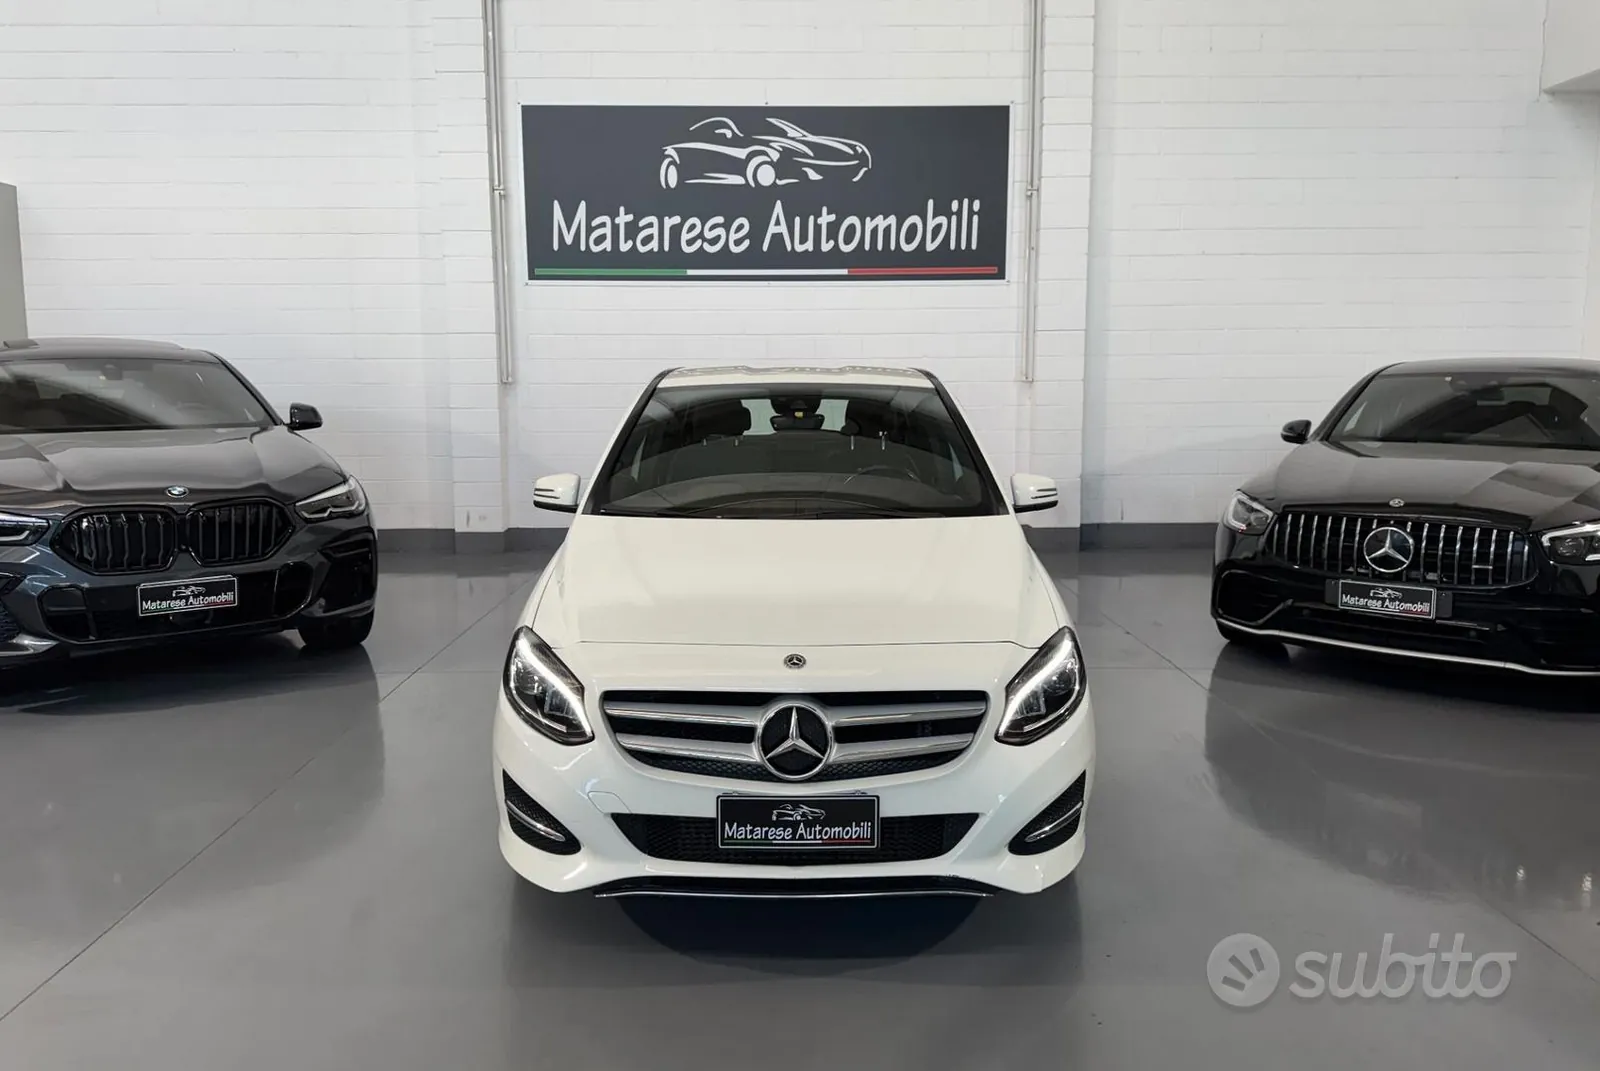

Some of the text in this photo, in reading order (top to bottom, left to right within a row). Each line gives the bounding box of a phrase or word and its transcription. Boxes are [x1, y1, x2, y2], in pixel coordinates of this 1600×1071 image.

[552, 198, 981, 253] Matarese Automobili
[142, 592, 234, 610] Matarese Automobili
[1342, 594, 1430, 612] Matarese Automobili
[724, 821, 871, 839] Matarese Automobili
